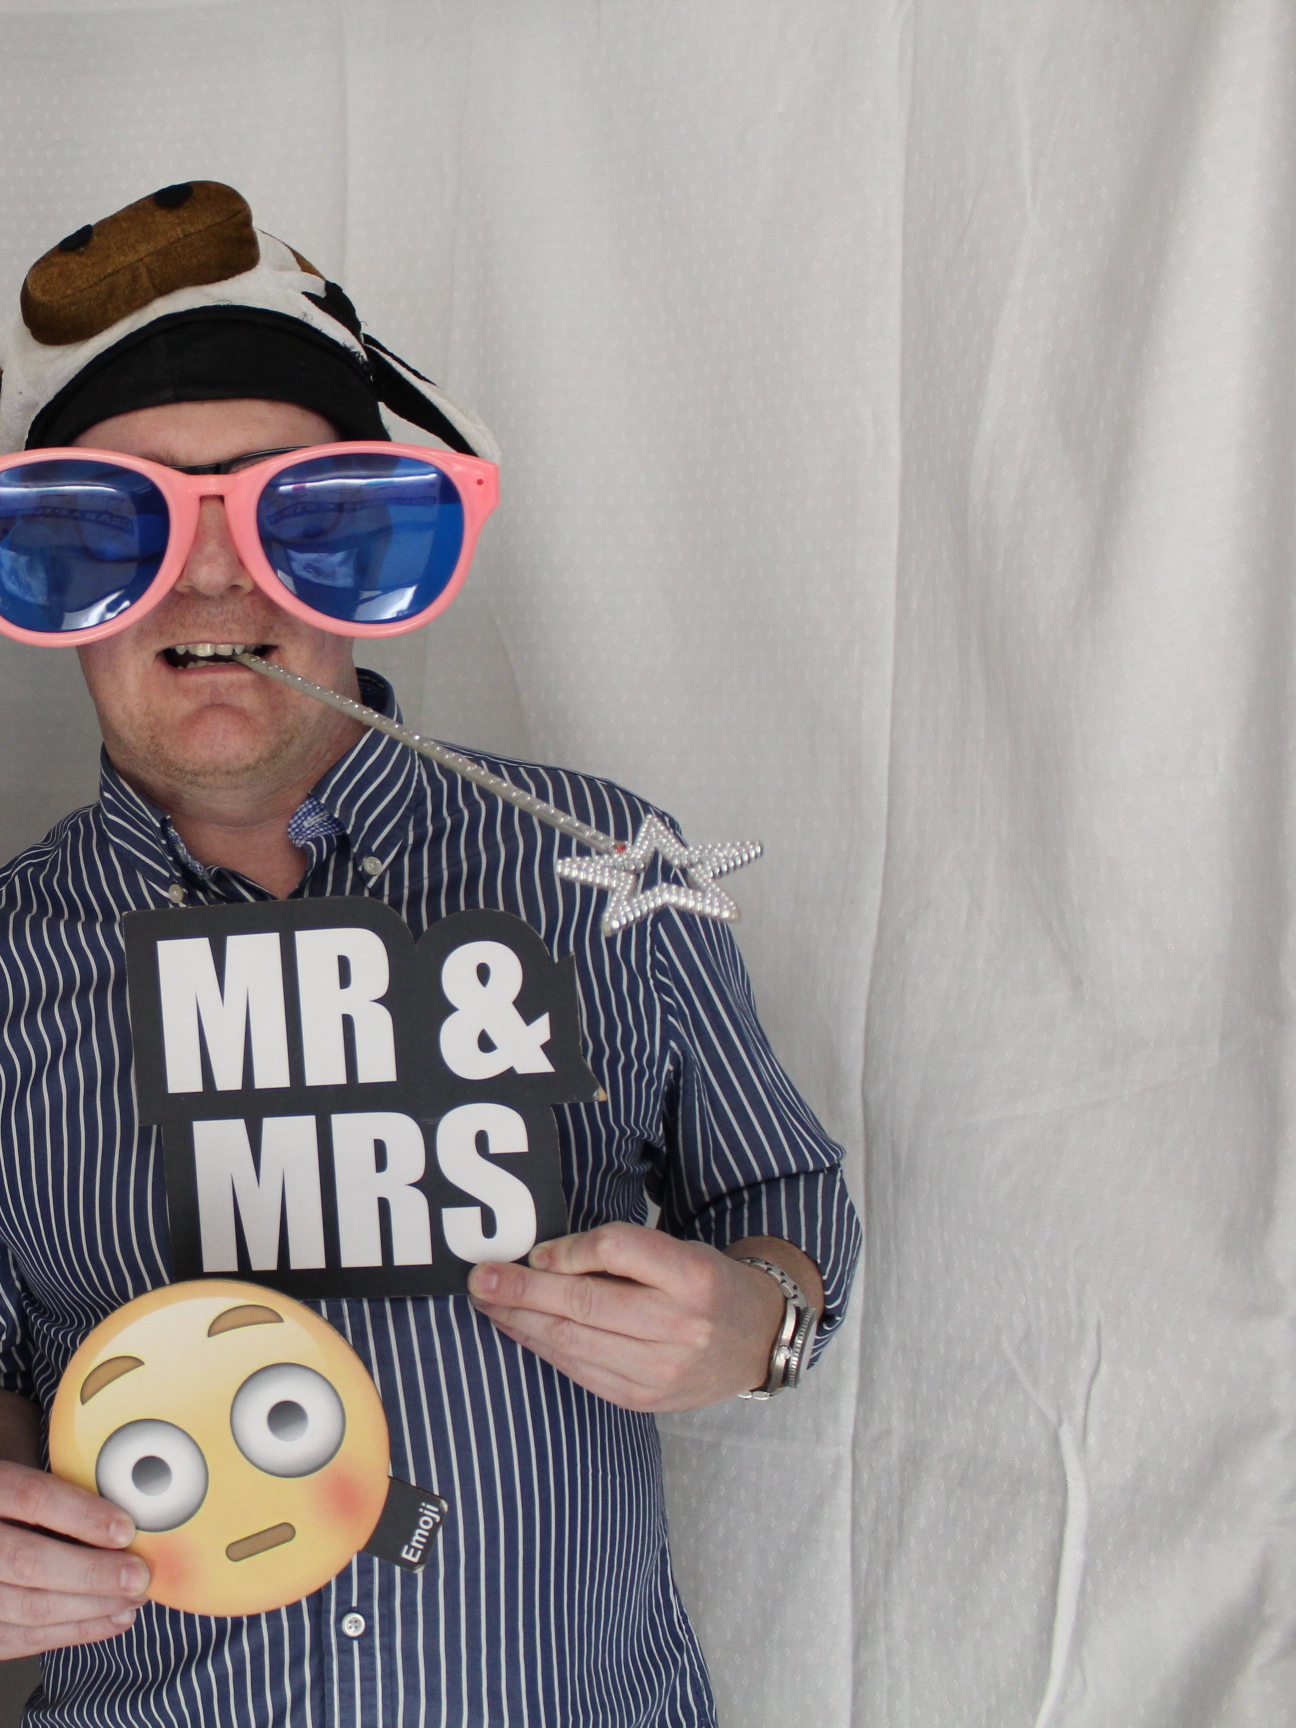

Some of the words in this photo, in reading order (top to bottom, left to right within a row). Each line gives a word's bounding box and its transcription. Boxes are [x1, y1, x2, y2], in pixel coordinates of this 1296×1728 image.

[157, 927, 398, 1094] MR
[439, 940, 556, 1081] &
[192, 1102, 538, 1273] MRS
[401, 1502, 441, 1563] Emoji
